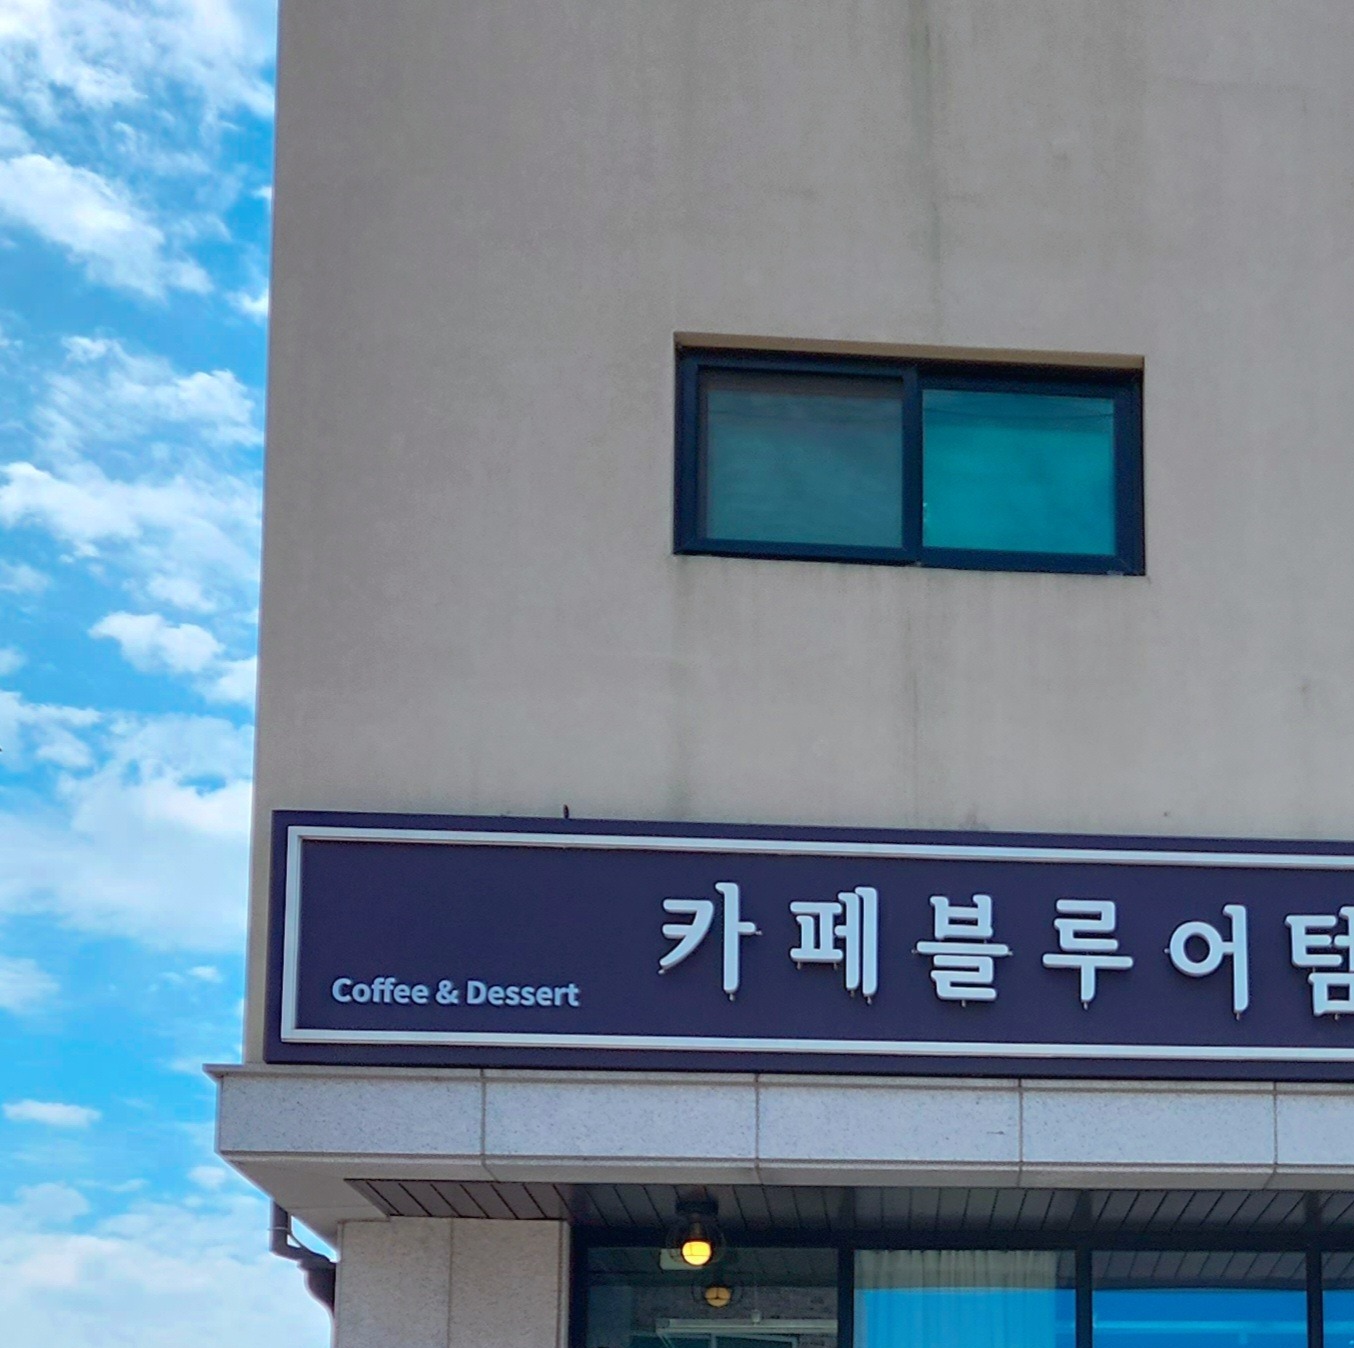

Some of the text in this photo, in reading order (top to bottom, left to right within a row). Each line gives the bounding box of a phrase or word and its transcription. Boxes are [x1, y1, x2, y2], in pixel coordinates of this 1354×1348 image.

[331, 977, 581, 1009] Coffee & Dessert
